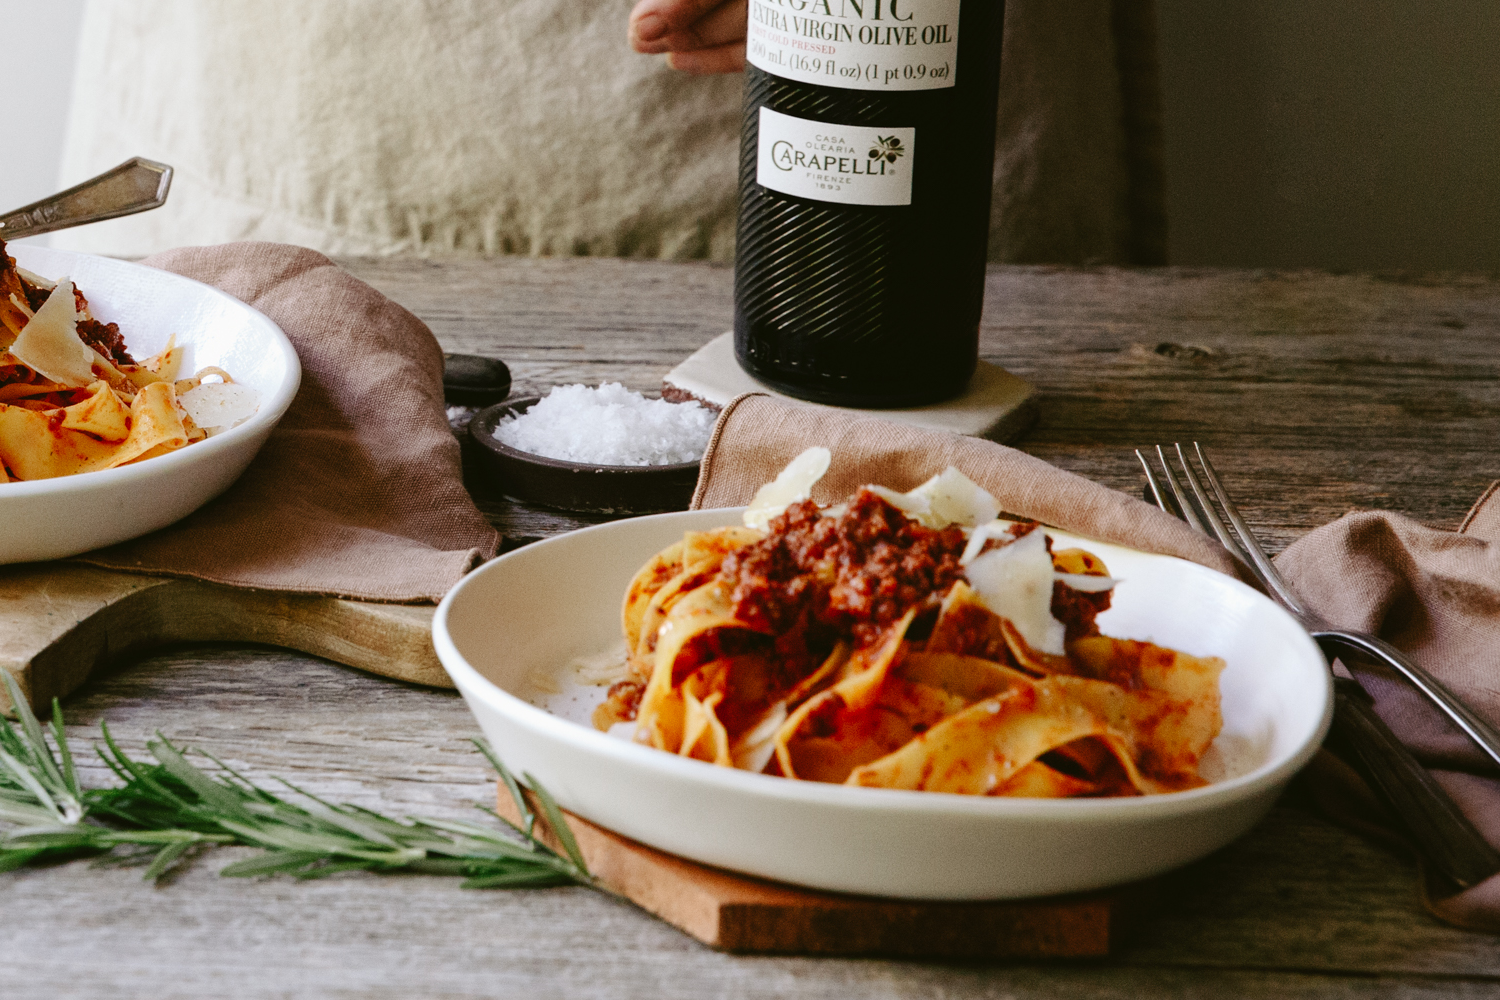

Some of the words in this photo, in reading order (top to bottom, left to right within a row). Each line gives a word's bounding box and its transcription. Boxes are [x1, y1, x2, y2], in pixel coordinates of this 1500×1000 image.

[752, 1, 789, 32] EXTRA
[792, 16, 854, 43] VIRGIN
[858, 25, 917, 45] OLIVE
[921, 24, 952, 45] OIL
[768, 32, 789, 46] COLD
[791, 39, 836, 55] PRESSED
[768, 49, 787, 66] mL
[789, 53, 821, 74] (16.9
[825, 60, 836, 76] fl
[839, 63, 861, 81] oz)
[865, 64, 879, 82] (1
[884, 68, 899, 85] pt
[903, 64, 926, 80] 0.9
[930, 62, 949, 80] oz)
[805, 141, 856, 154] OLEARIA
[815, 134, 846, 144] CASA
[771, 139, 886, 175] CARAPELLI
[806, 172, 852, 185] FIRENZE
[815, 182, 842, 192] 1893
